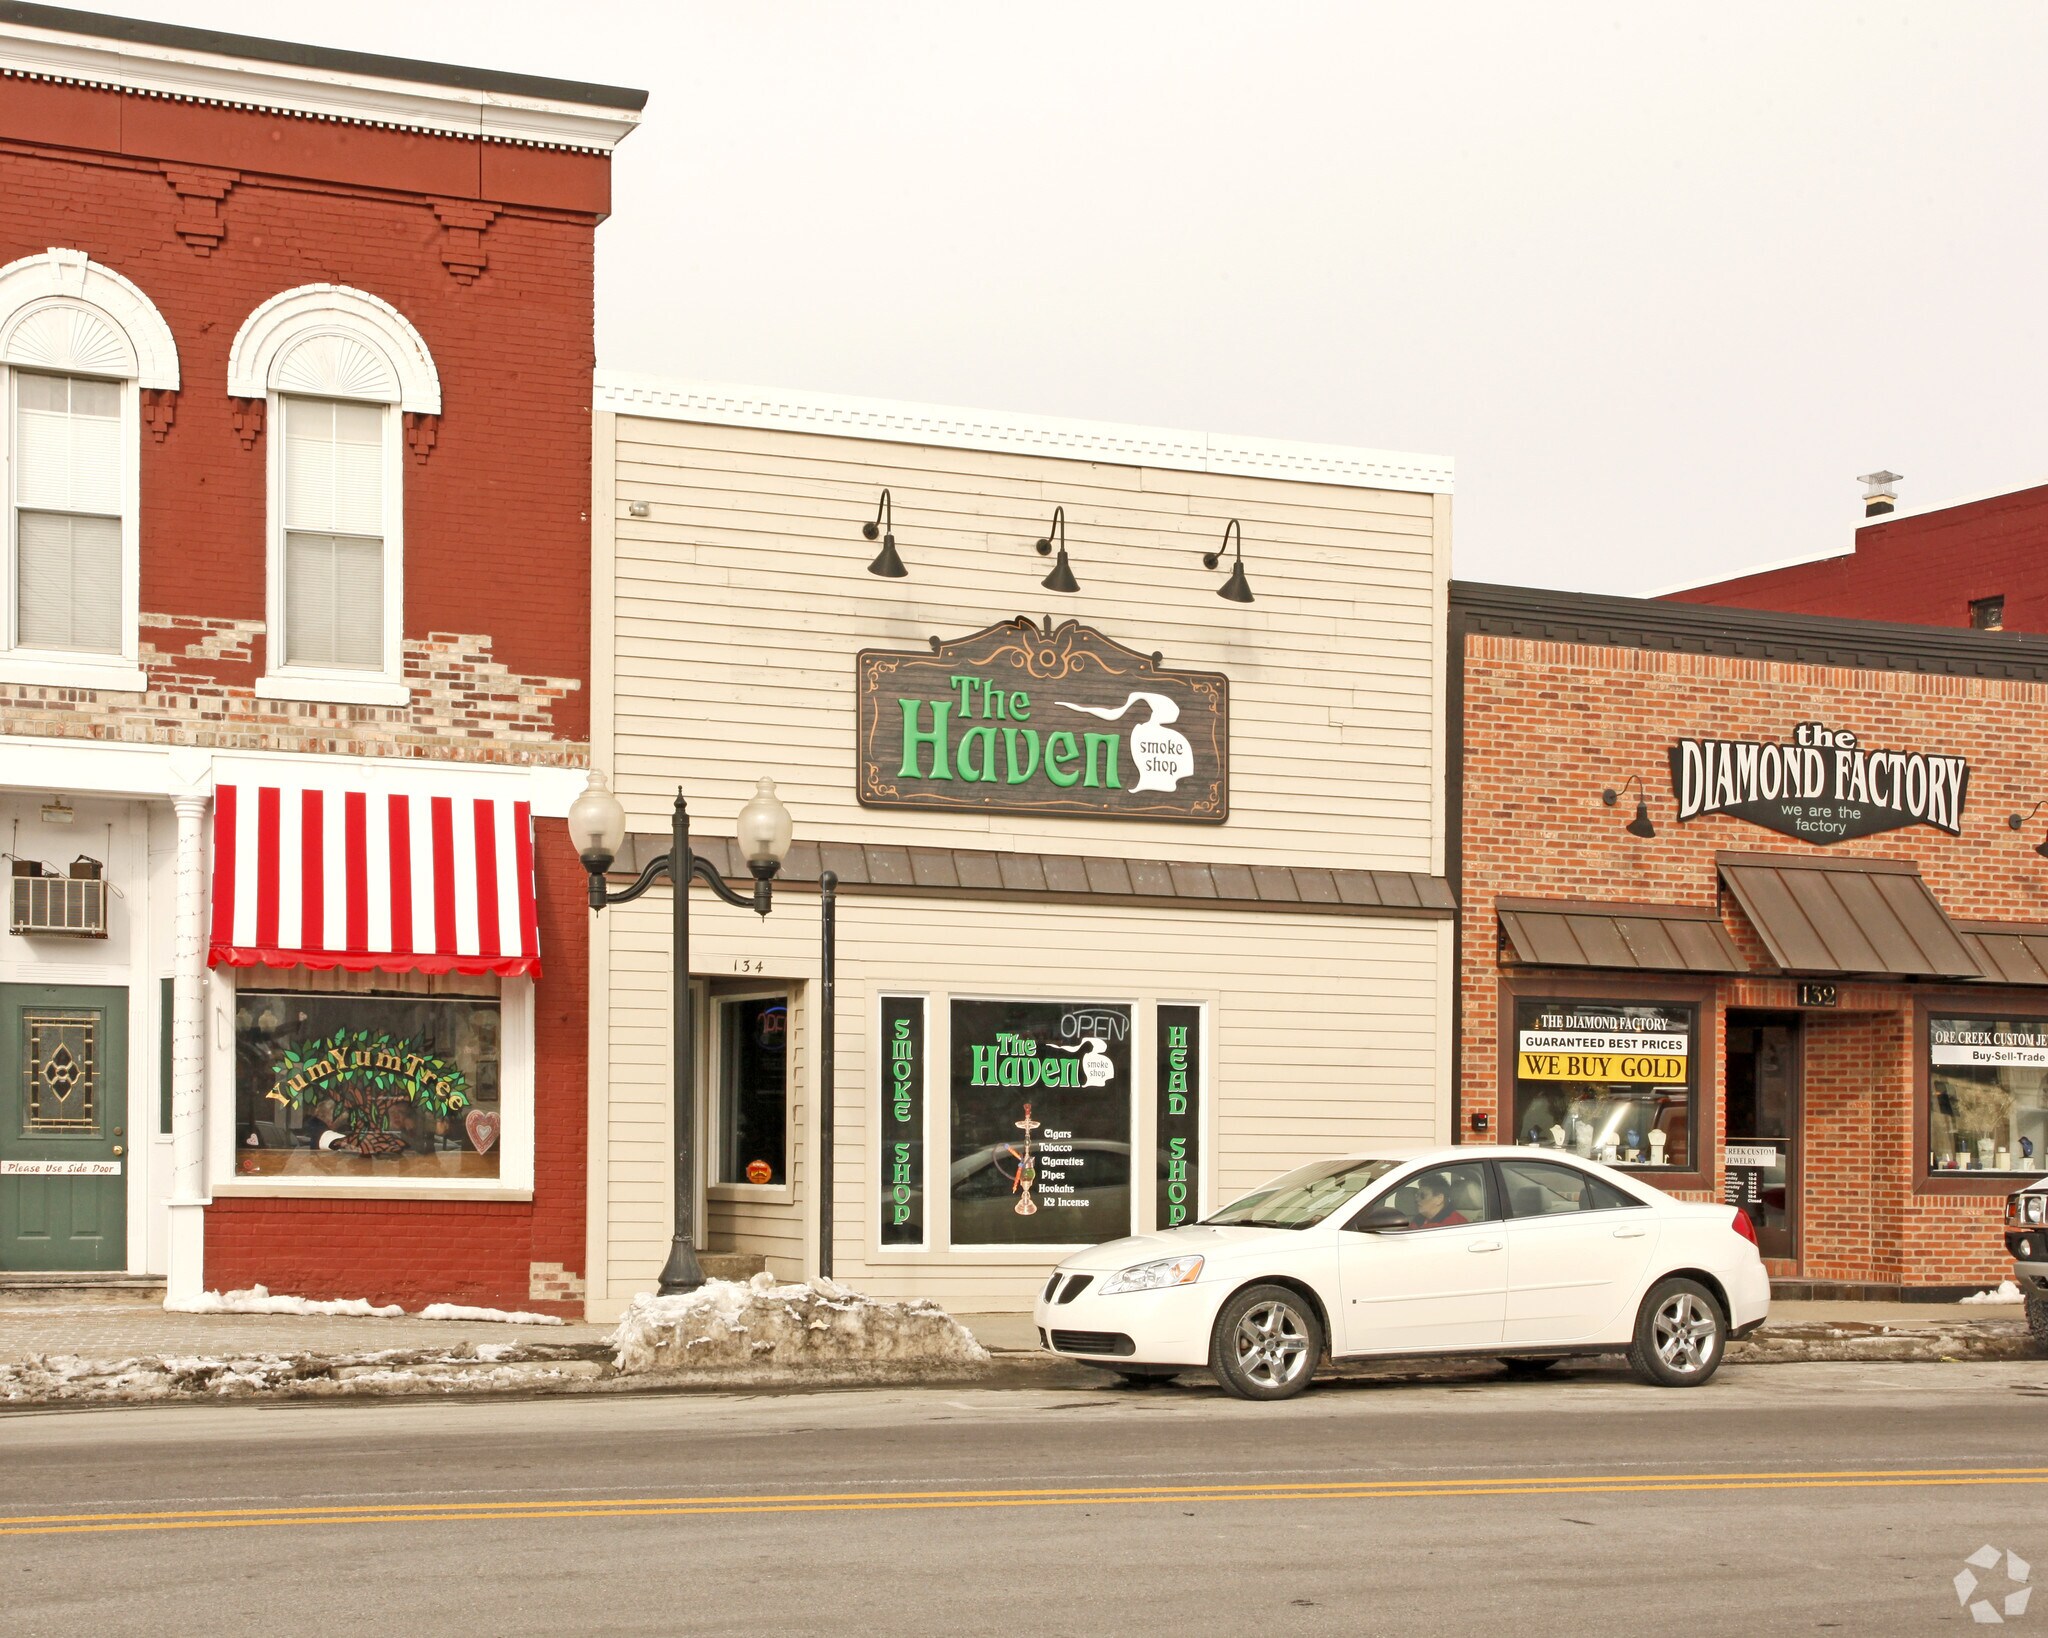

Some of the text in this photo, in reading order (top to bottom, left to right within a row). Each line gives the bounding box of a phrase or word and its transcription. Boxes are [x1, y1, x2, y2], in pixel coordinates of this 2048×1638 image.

[951, 675, 1031, 722] The
[897, 698, 1123, 790] Haven
[1796, 724, 1856, 749] the
[1139, 739, 1184, 756] smoke
[1145, 756, 1178, 776] shop
[1679, 740, 1966, 833] DIAMOND FACTORY
[1781, 805, 1861, 820] we are the
[1795, 817, 1847, 836] factory
[733, 959, 764, 974] 134
[1802, 984, 1836, 1006] 132
[1060, 1013, 1126, 1042] OPEN
[1541, 1014, 1668, 1031] THE DIAMOND FACTORY
[996, 1032, 1037, 1057] The
[1525, 1036, 1683, 1050] GUARANTEED BEST PRICES
[1935, 1030, 1956, 1044] ORE
[1958, 1031, 1992, 1045] CREEK
[1993, 1032, 2034, 1047] CUSTOM
[1086, 1059, 1109, 1069] smoke
[1972, 1051, 2046, 1063] Buy-Sell-Trade
[970, 1044, 1081, 1088] Haven
[1089, 1069, 1106, 1079] shop
[1525, 1054, 1682, 1078] WE BUY GOLD
[891, 1018, 914, 1226] SMOKE SHOP
[1168, 1026, 1188, 1227] HEAD SHOP
[1043, 1128, 1072, 1140] Cigars
[1039, 1142, 1073, 1152] Tobacco
[1725, 1148, 1746, 1156] REEK
[7, 1163, 114, 1173] Please Use Side Door
[1041, 1156, 1085, 1167] Cigarettes
[1041, 1170, 1066, 1181] Pipes
[1038, 1183, 1075, 1193] Hookahs
[1043, 1197, 1090, 1207] K2 Incense
